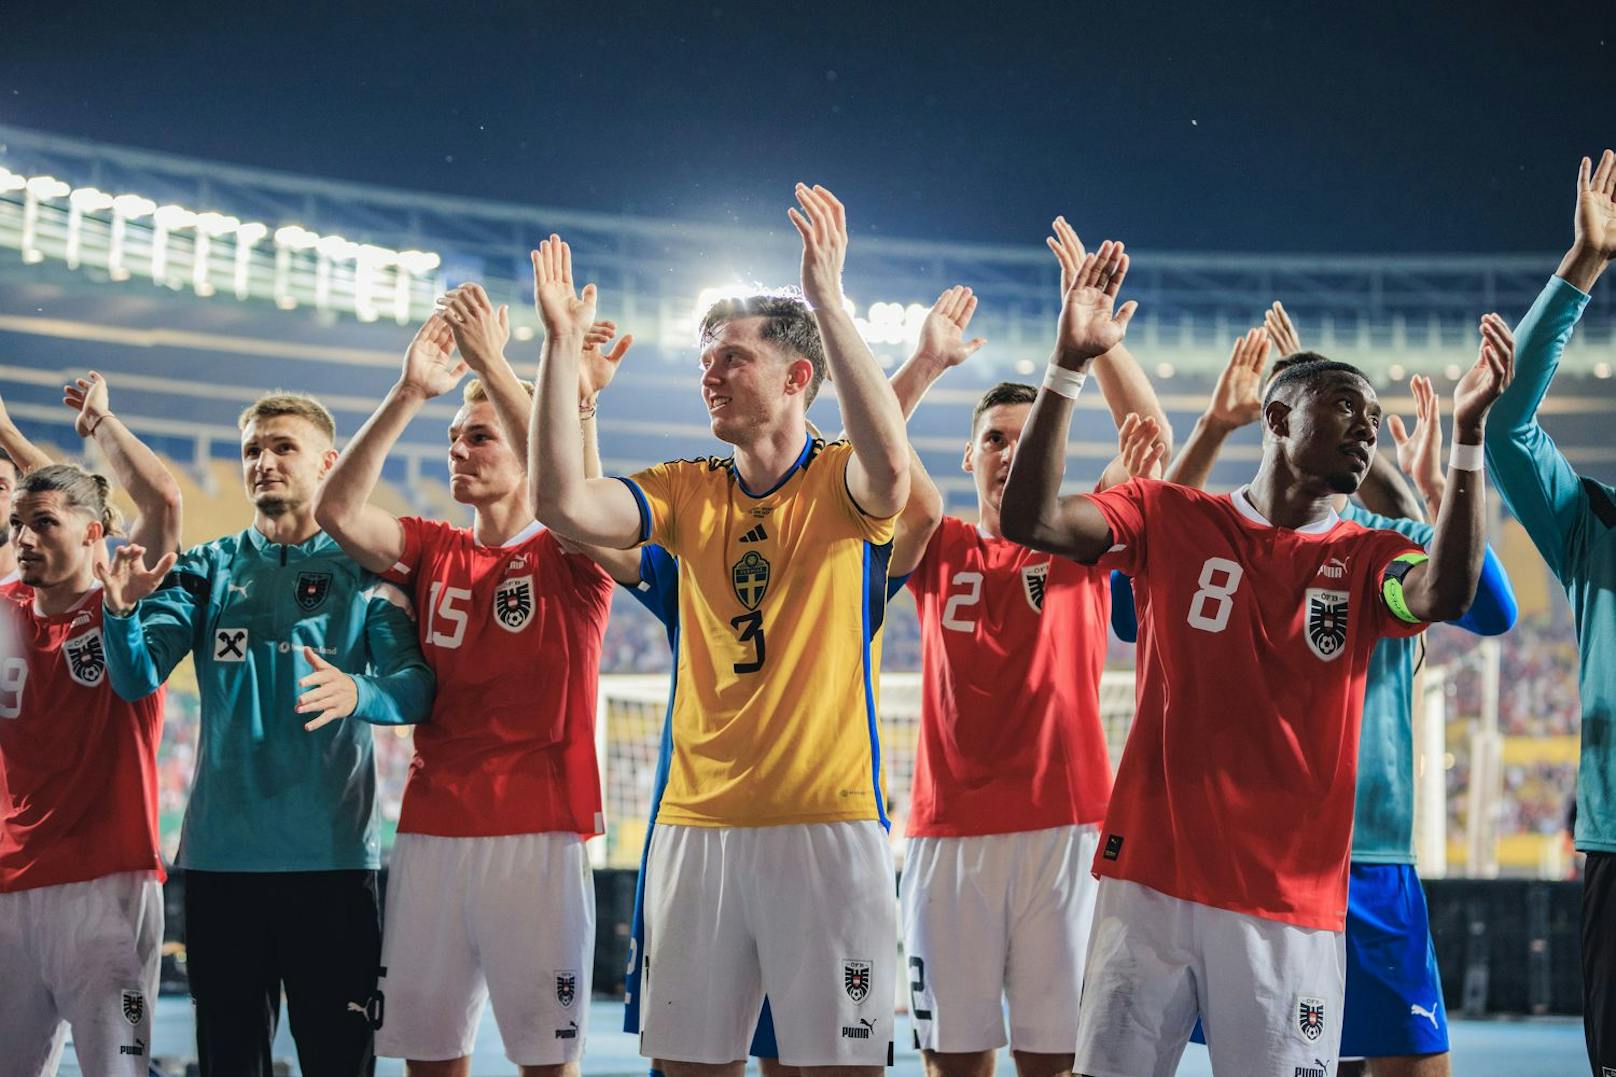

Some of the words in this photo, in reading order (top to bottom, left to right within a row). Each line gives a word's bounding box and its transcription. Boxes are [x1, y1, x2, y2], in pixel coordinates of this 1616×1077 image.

[425, 581, 472, 649] 15
[942, 571, 984, 633] 2
[1187, 557, 1244, 633] 8
[730, 609, 766, 673] 3
[909, 956, 932, 1020] 2
[842, 1026, 869, 1039] PUMA
[1294, 1066, 1324, 1077] PUMA
